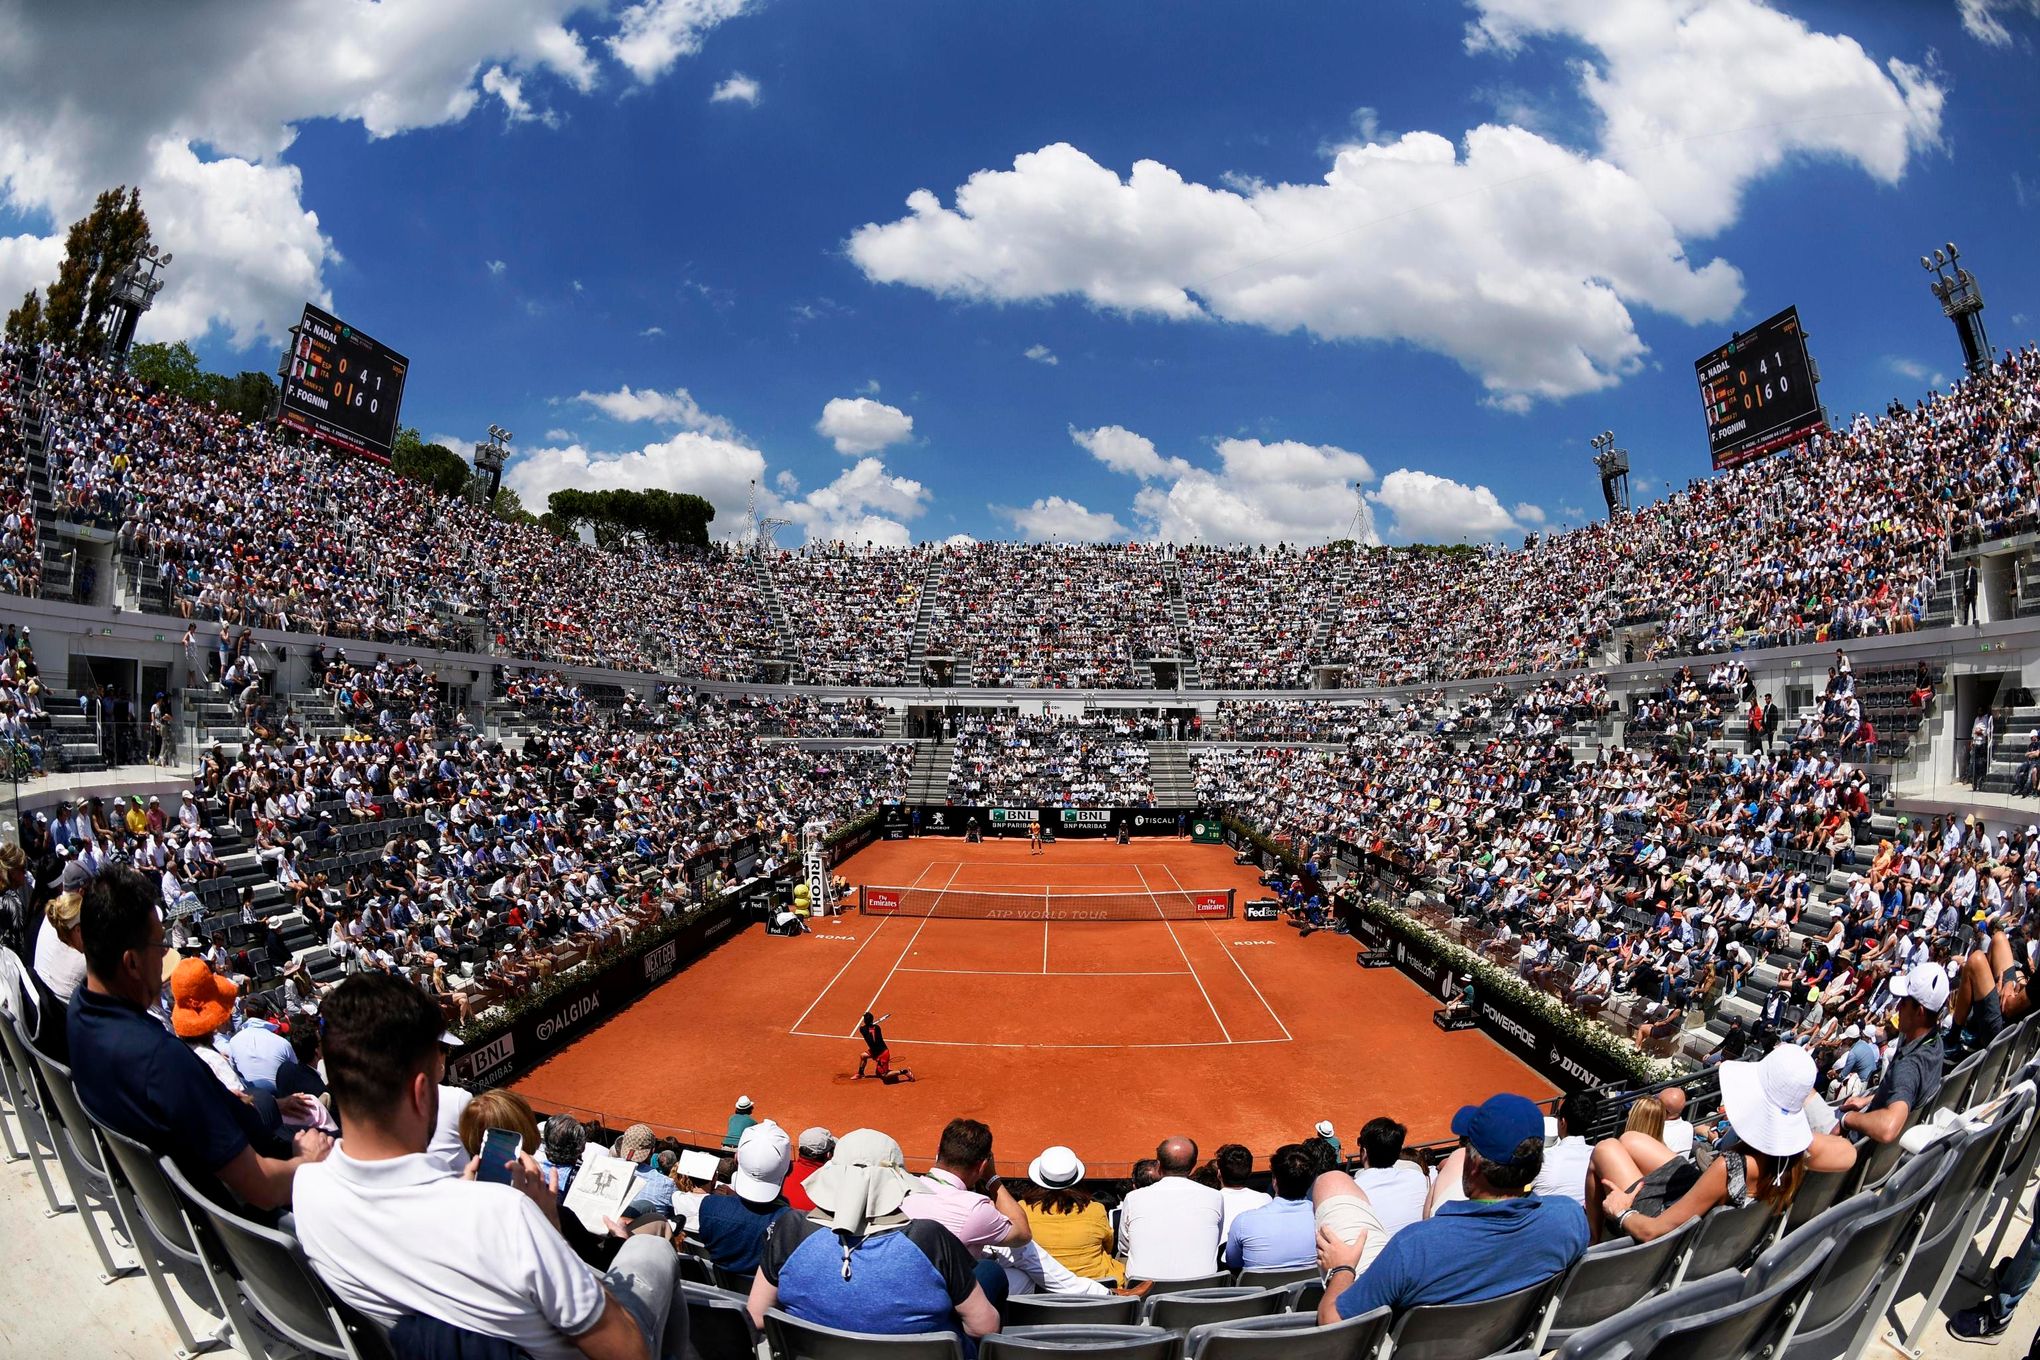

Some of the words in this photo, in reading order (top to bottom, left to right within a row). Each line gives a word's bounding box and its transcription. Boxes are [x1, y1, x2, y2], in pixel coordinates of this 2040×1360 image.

[304, 320, 312, 332] R.
[313, 324, 338, 344] NADAL
[320, 370, 329, 378] ITA
[322, 361, 332, 370] ESP
[339, 358, 347, 374] 0
[360, 370, 368, 384] 4
[376, 376, 382, 390] 1
[1700, 372, 1708, 382] R.
[1708, 360, 1730, 378] NADAL
[1740, 370, 1747, 386] 0
[1760, 359, 1768, 376] 4
[1774, 352, 1782, 368] 1
[288, 384, 296, 396] F.
[296, 388, 329, 410] FOGNINI
[334, 382, 342, 397] 0
[356, 392, 364, 406] 6
[370, 399, 378, 414] 0
[1744, 394, 1752, 409] 0
[1765, 383, 1772, 400] 6
[1780, 376, 1788, 392] 0
[1711, 432, 1718, 442] F.
[1718, 419, 1746, 440] FOGNINI
[1008, 811, 1037, 820] BNL
[1080, 811, 1106, 820] BNL
[811, 860, 821, 908] RICOH
[869, 898, 897, 908] Emirates
[986, 910, 1012, 918] ATP
[1017, 910, 1067, 919] WORLD
[1072, 910, 1108, 920] TOUR
[1248, 906, 1276, 917] FedEx
[644, 950, 662, 974] NEXT
[662, 942, 676, 964] GEN
[1406, 952, 1436, 981] Hotels.com
[555, 993, 600, 1032] ALGIDA
[1482, 1002, 1536, 1048] POWERADE
[475, 1039, 510, 1073] BNL
[479, 1062, 512, 1088] PARIBAS
